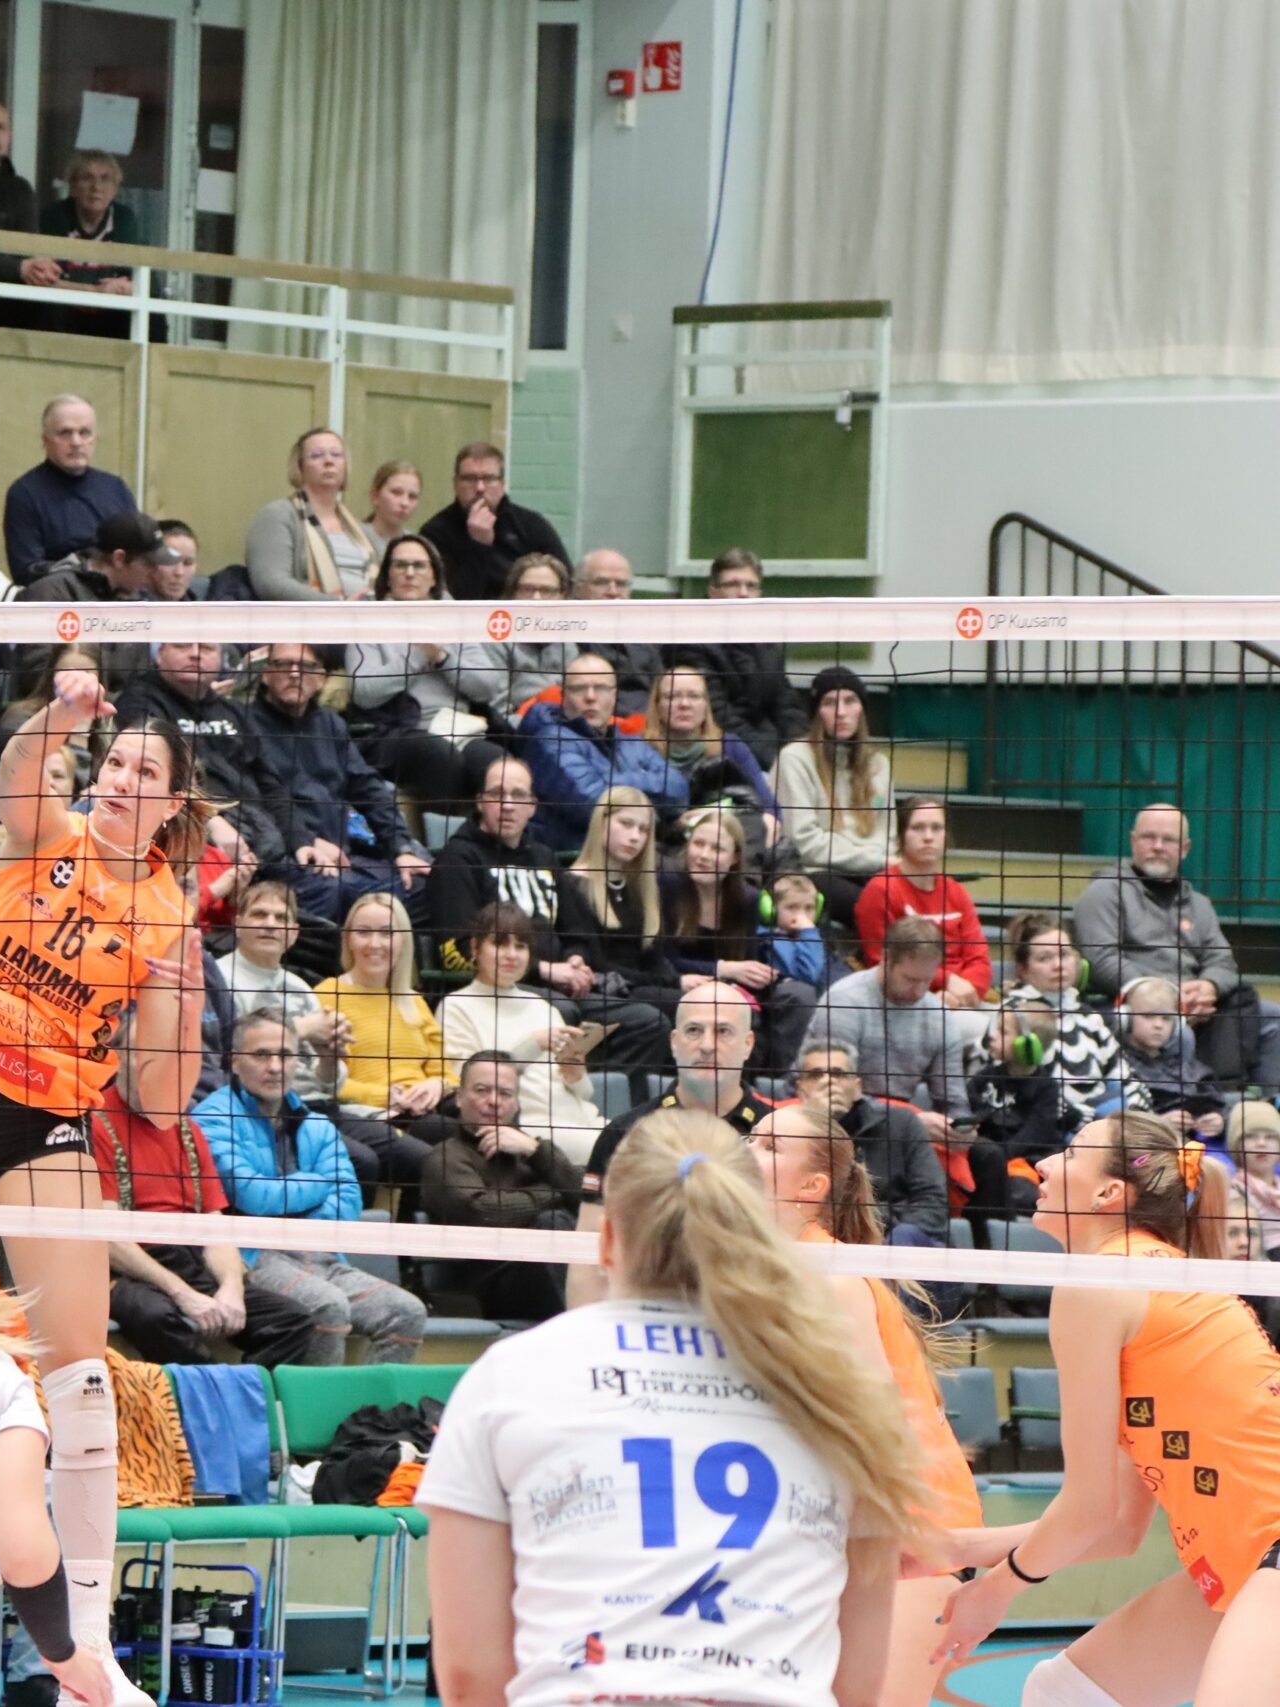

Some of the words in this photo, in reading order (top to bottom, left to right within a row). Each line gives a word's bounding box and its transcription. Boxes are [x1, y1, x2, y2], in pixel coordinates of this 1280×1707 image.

[83, 617, 99, 632] OP
[101, 617, 152, 632] Kuusamo
[514, 616, 532, 631] OP
[534, 617, 588, 631] Kuusamo
[988, 614, 1006, 629] OP
[1008, 614, 1068, 628] Kuusamo
[43, 906, 95, 961] 16
[616, 1325, 727, 1359] LEHT
[622, 1437, 779, 1551] 19
